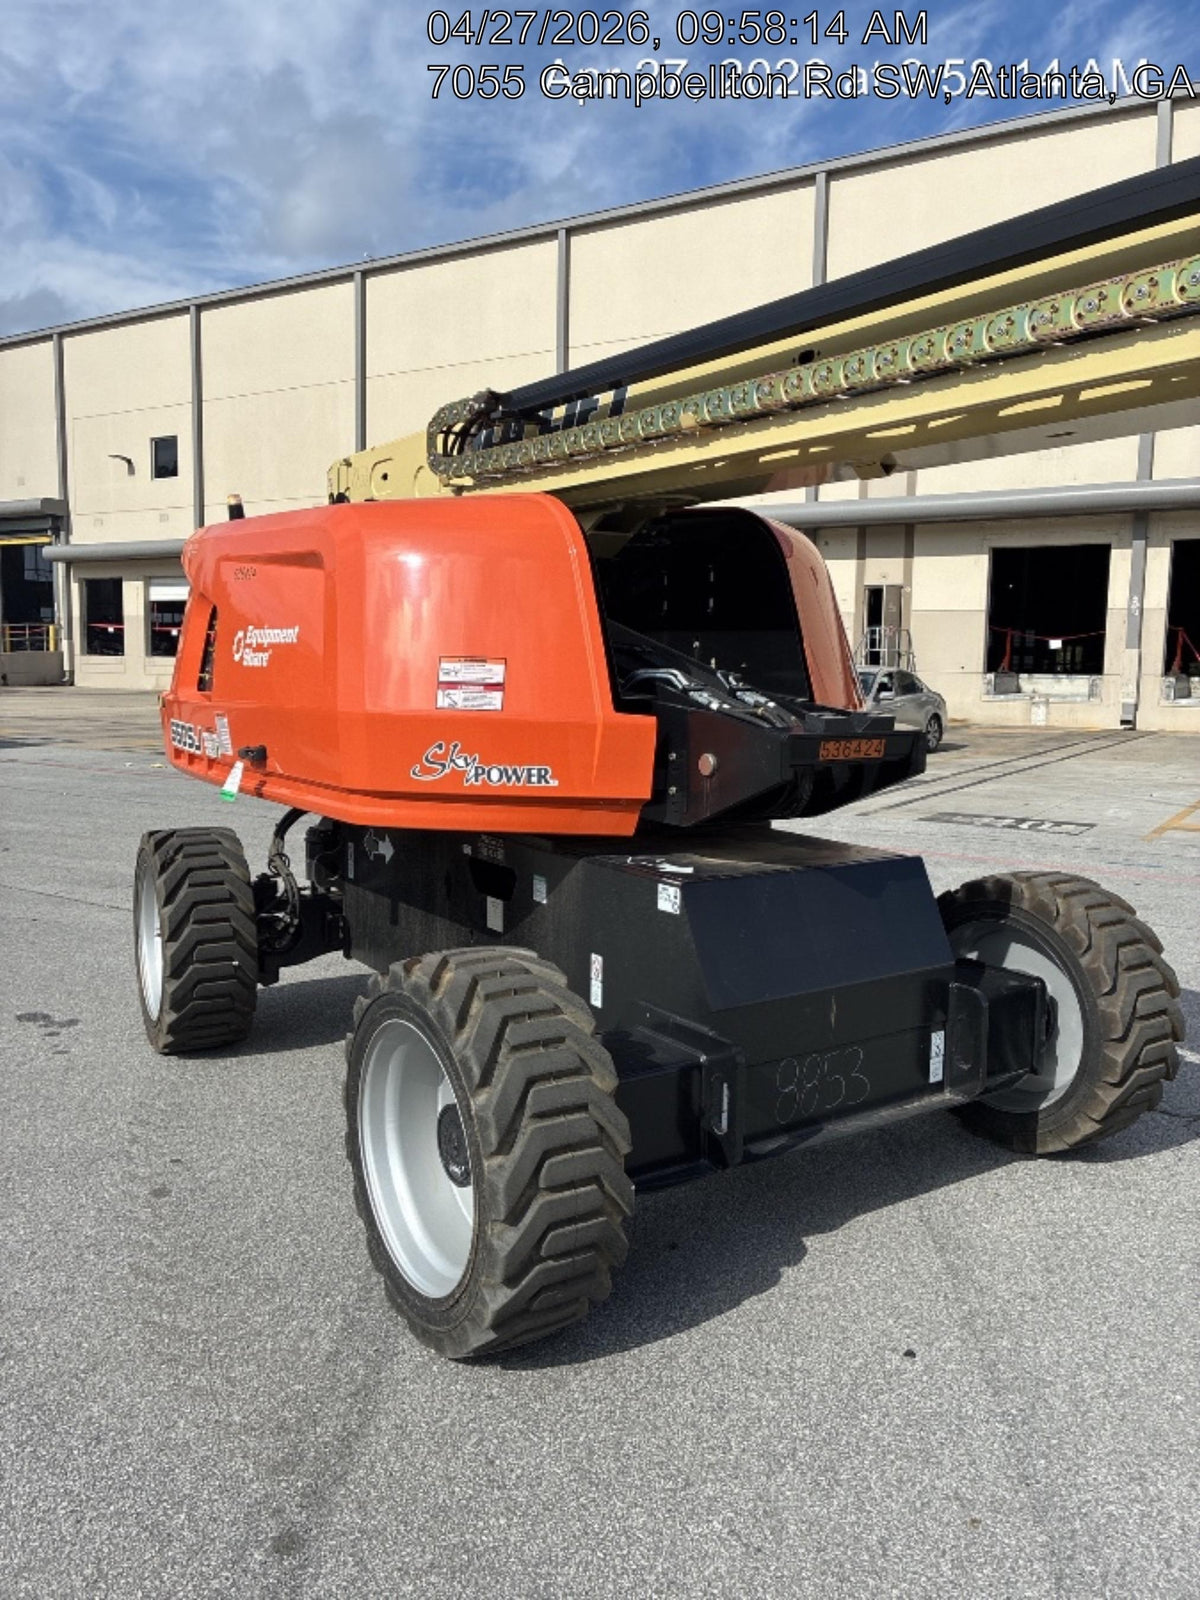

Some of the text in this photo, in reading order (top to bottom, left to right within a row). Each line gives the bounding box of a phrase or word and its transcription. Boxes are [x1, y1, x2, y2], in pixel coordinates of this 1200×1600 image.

[244, 625, 299, 647] Equipment
[242, 649, 270, 668] Share
[820, 739, 884, 758] 536424
